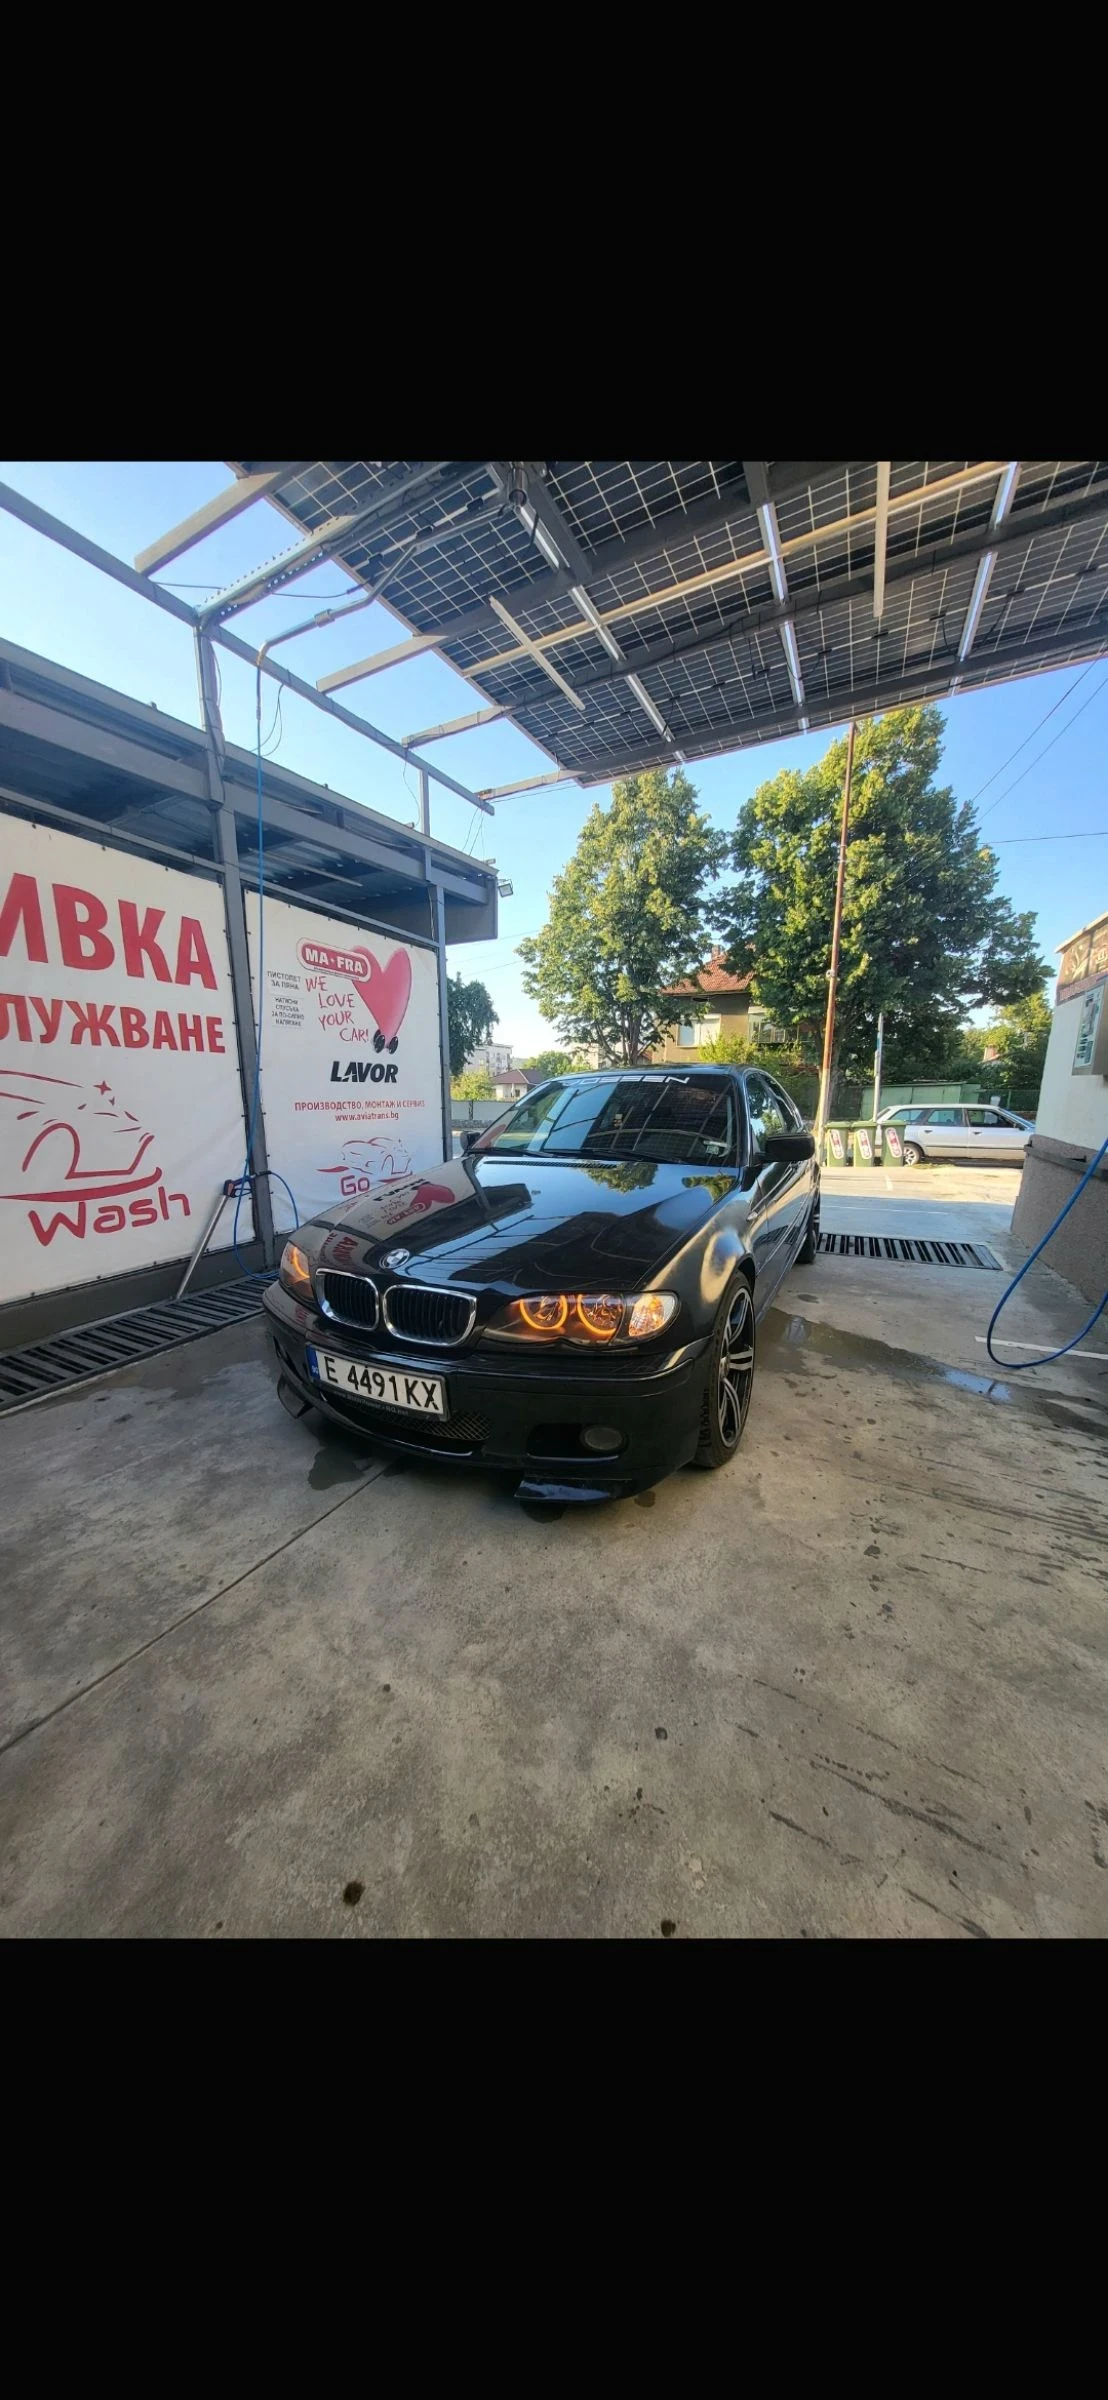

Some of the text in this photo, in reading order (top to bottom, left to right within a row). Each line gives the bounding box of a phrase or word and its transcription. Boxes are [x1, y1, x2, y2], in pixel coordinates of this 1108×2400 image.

[305, 976, 328, 992] WE
[318, 993, 356, 1009] LOVE
[318, 1010, 354, 1031] YOUR
[339, 1028, 369, 1043] CAR!
[330, 1061, 399, 1083] LAVOR
[294, 1100, 364, 1112] ПРОИЗВОДСТВО,
[365, 1100, 395, 1110] МОНТАЖ
[396, 1100, 402, 1108] И
[335, 1111, 399, 1121] www.aviatrans.bg
[340, 1175, 370, 1196] Go
[28, 1186, 191, 1247] Wash
[324, 1356, 339, 1384] E
